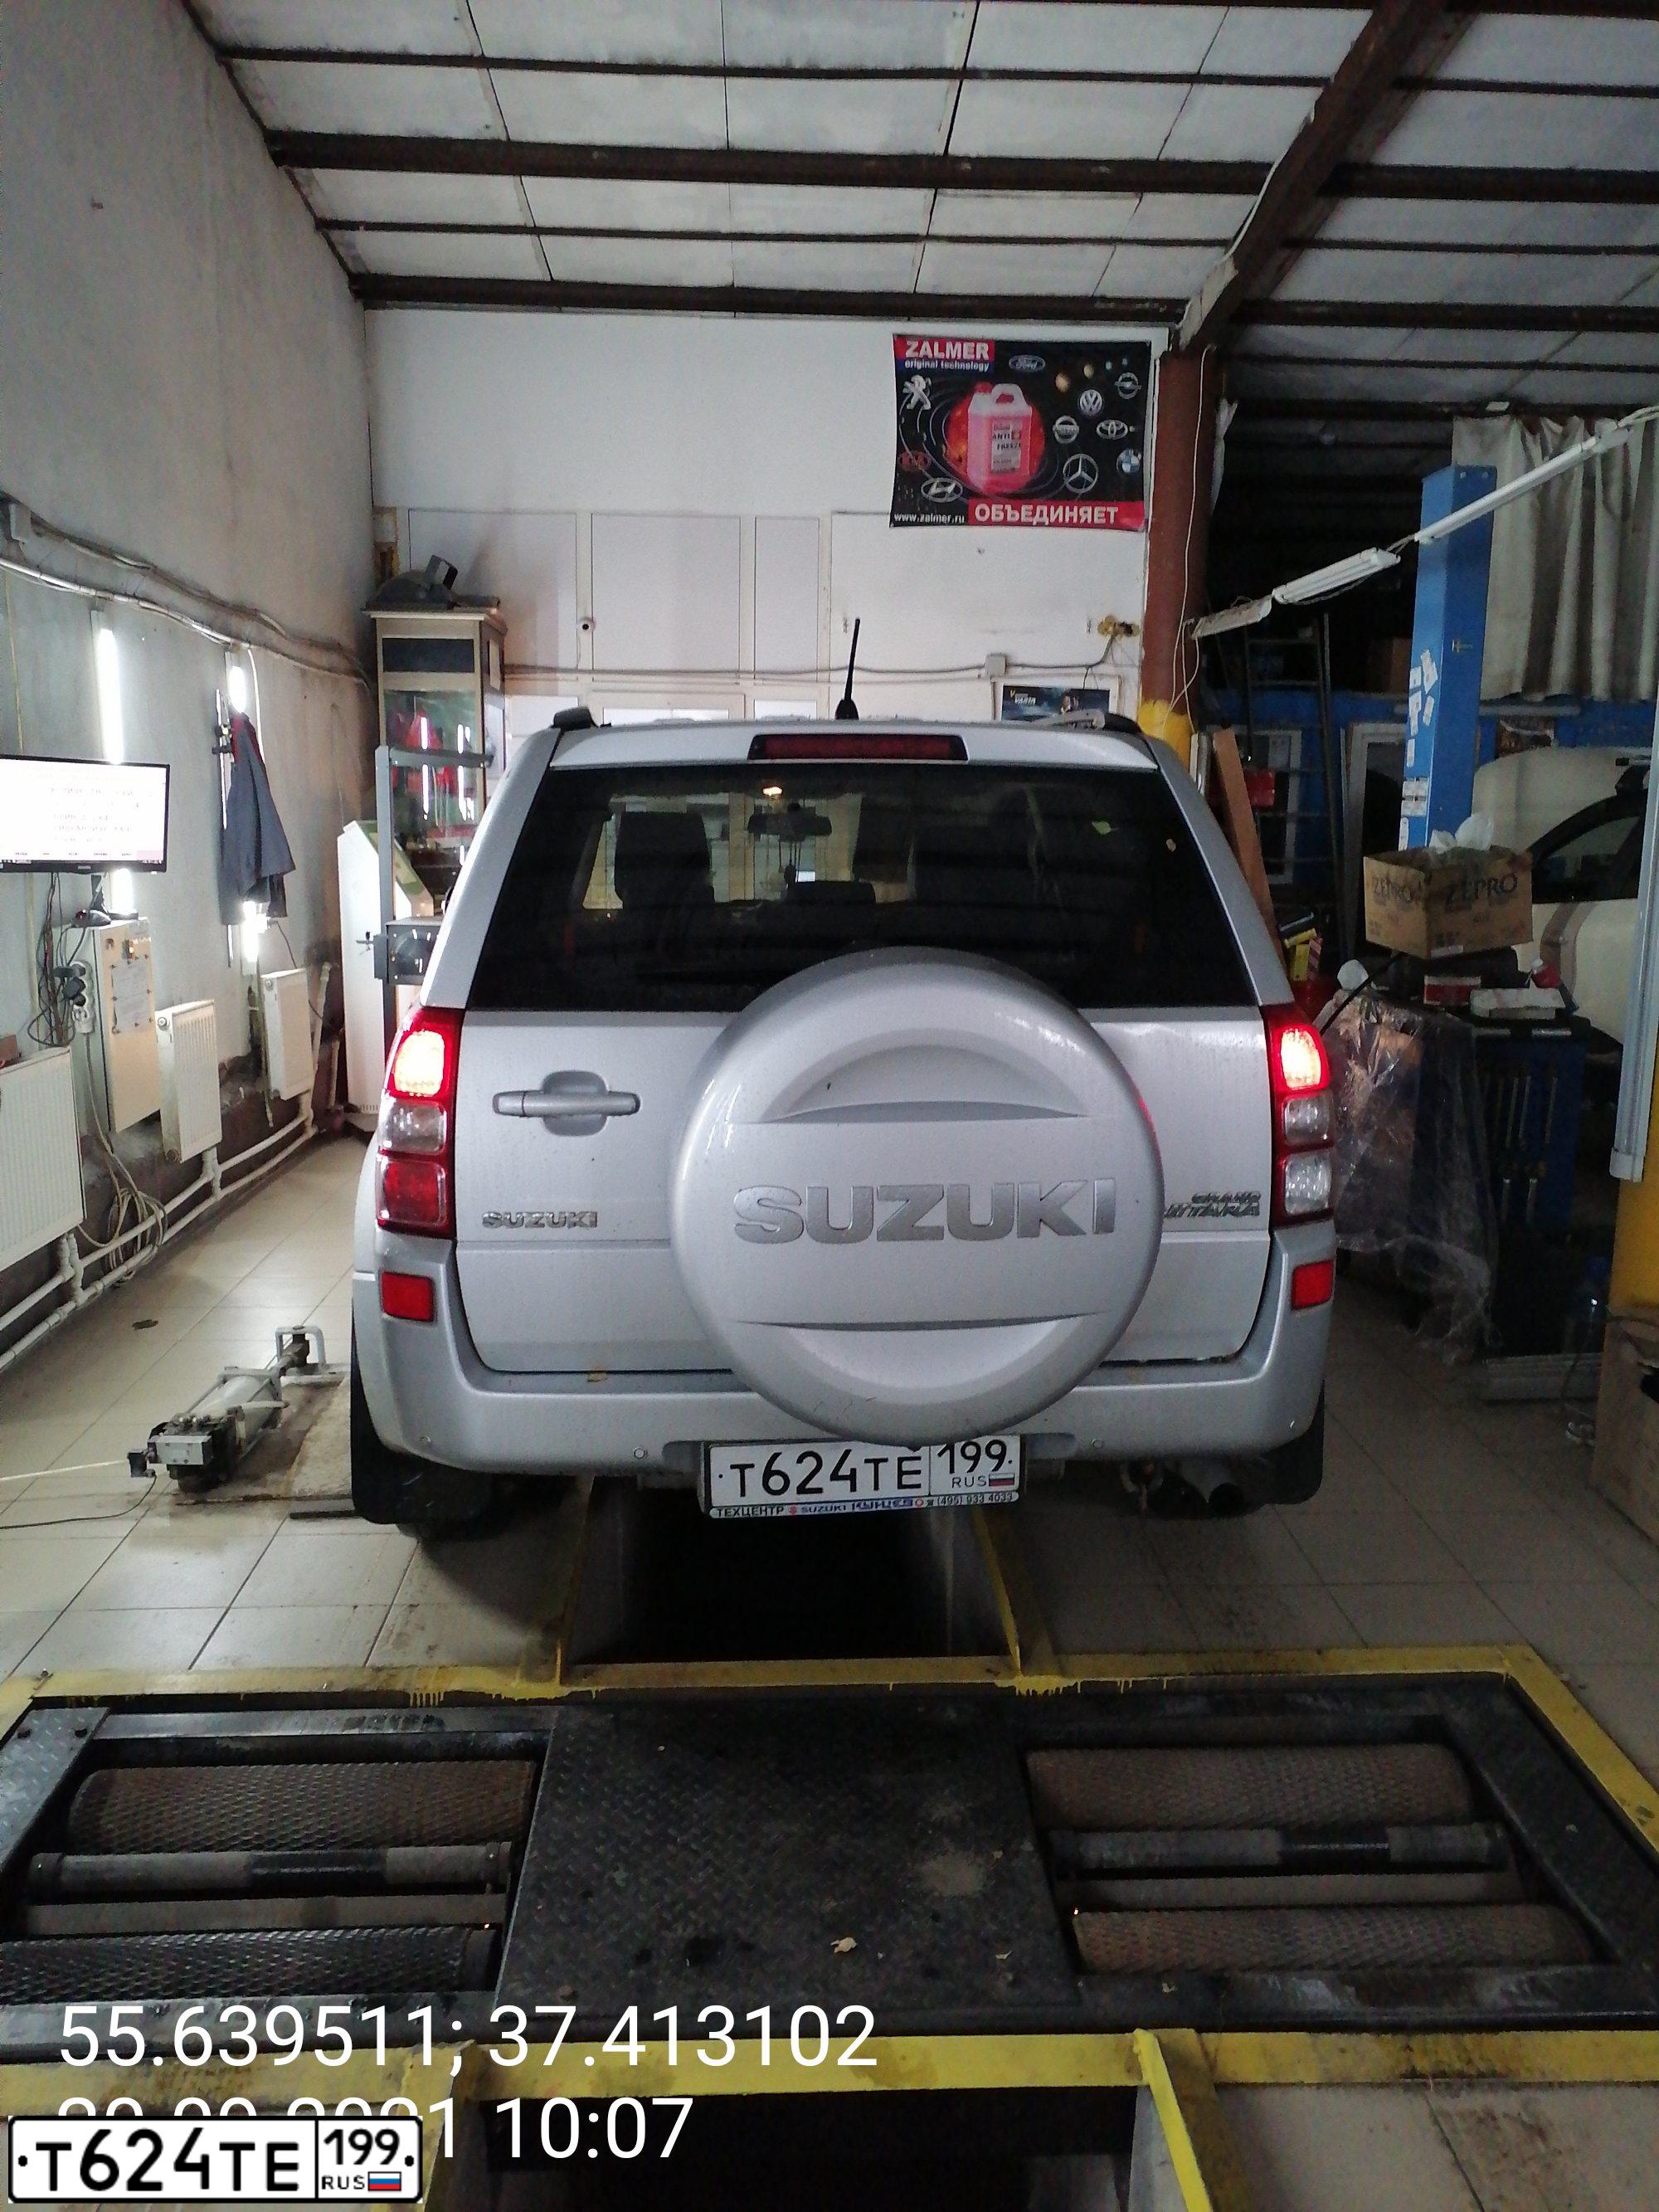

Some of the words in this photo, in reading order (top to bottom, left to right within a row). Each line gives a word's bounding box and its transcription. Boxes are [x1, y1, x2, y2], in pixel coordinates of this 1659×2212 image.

[905, 340, 990, 360] ZALMER
[904, 358, 938, 370] original
[941, 359, 990, 373] technology
[893, 512, 965, 524] www.zalmer.ru
[974, 503, 1119, 526] ОБЪЕДИНЯЕТ
[482, 1211, 598, 1229] SUZUKI
[733, 1177, 1117, 1245] SUZUKI
[937, 1439, 1008, 1474] 199
[951, 1474, 987, 1489] RUS
[718, 1506, 785, 1518] ТЕХЦЕНТР
